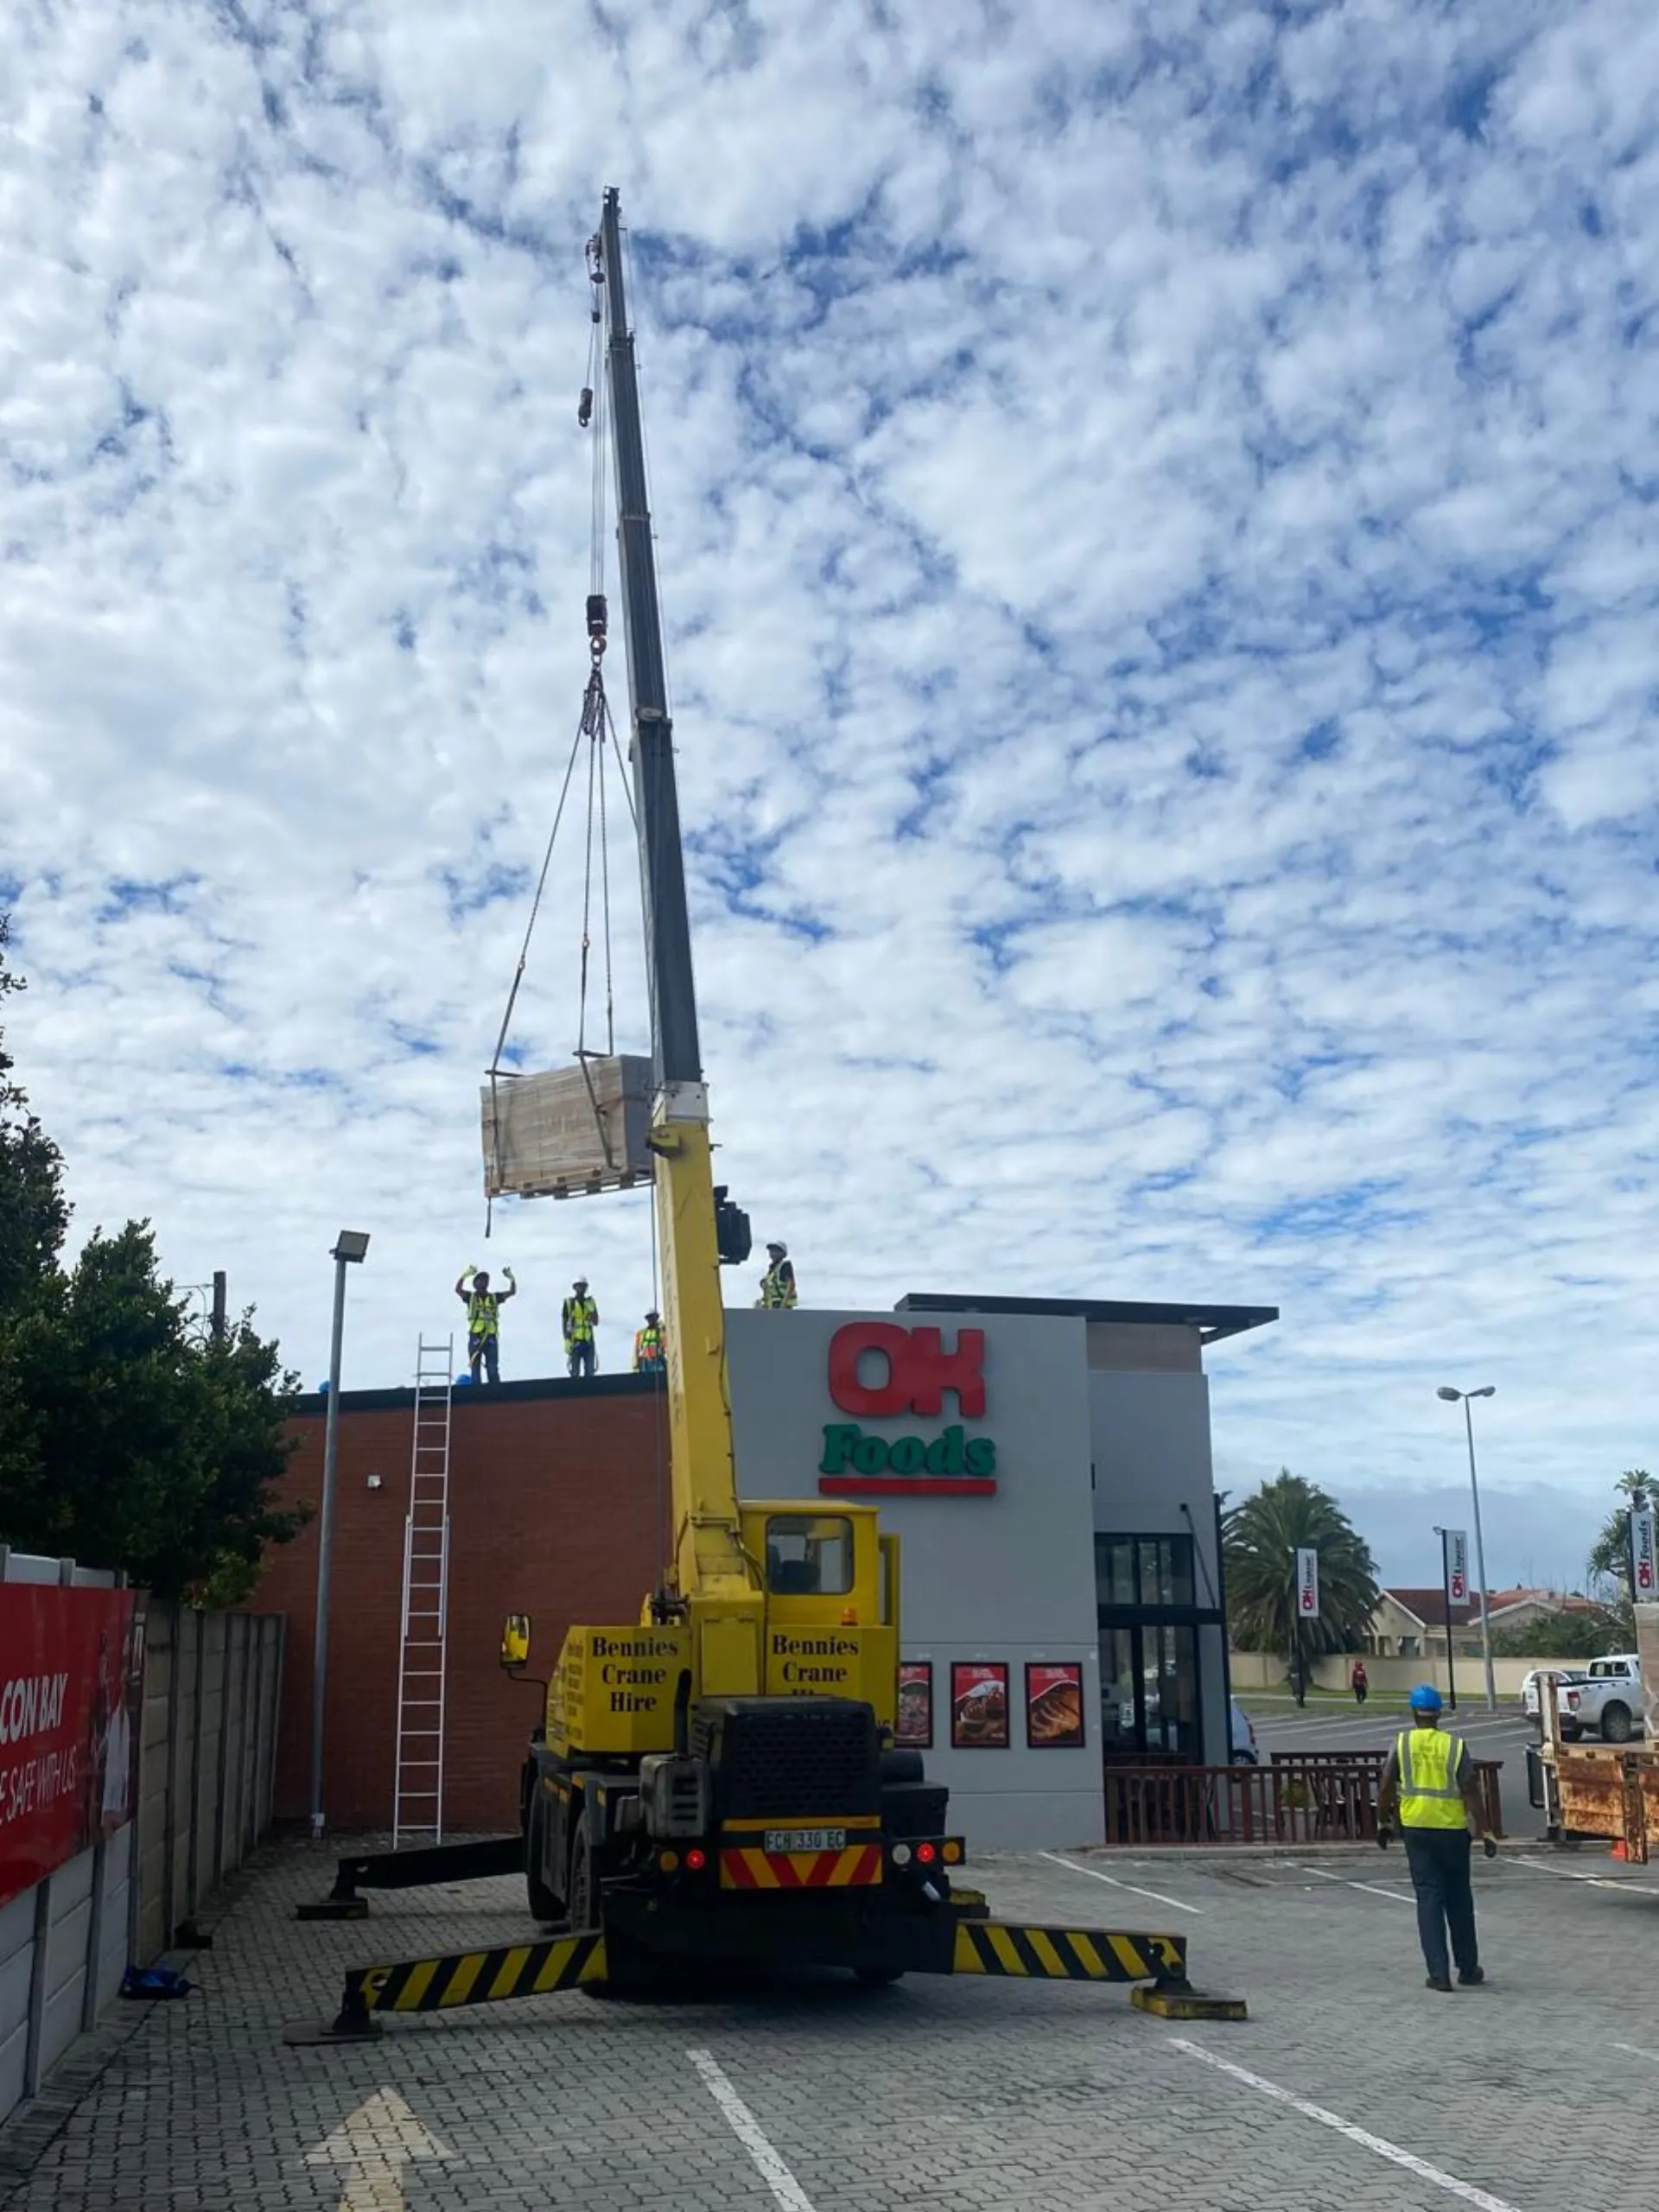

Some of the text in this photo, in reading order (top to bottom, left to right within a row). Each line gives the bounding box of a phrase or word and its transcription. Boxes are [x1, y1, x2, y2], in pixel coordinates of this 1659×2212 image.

[828, 1321, 986, 1418] OK
[818, 1424, 996, 1476] Foods
[593, 1637, 678, 1657] Bennies
[772, 1634, 858, 1656] Bennies
[602, 1663, 667, 1684] Crane
[783, 1660, 849, 1682] Crane
[39, 1673, 68, 1732] BAY
[610, 1692, 657, 1712] Hire
[5, 1759, 36, 1822] SAFE
[798, 1833, 822, 1848] 330
[827, 1831, 844, 1847] EC
